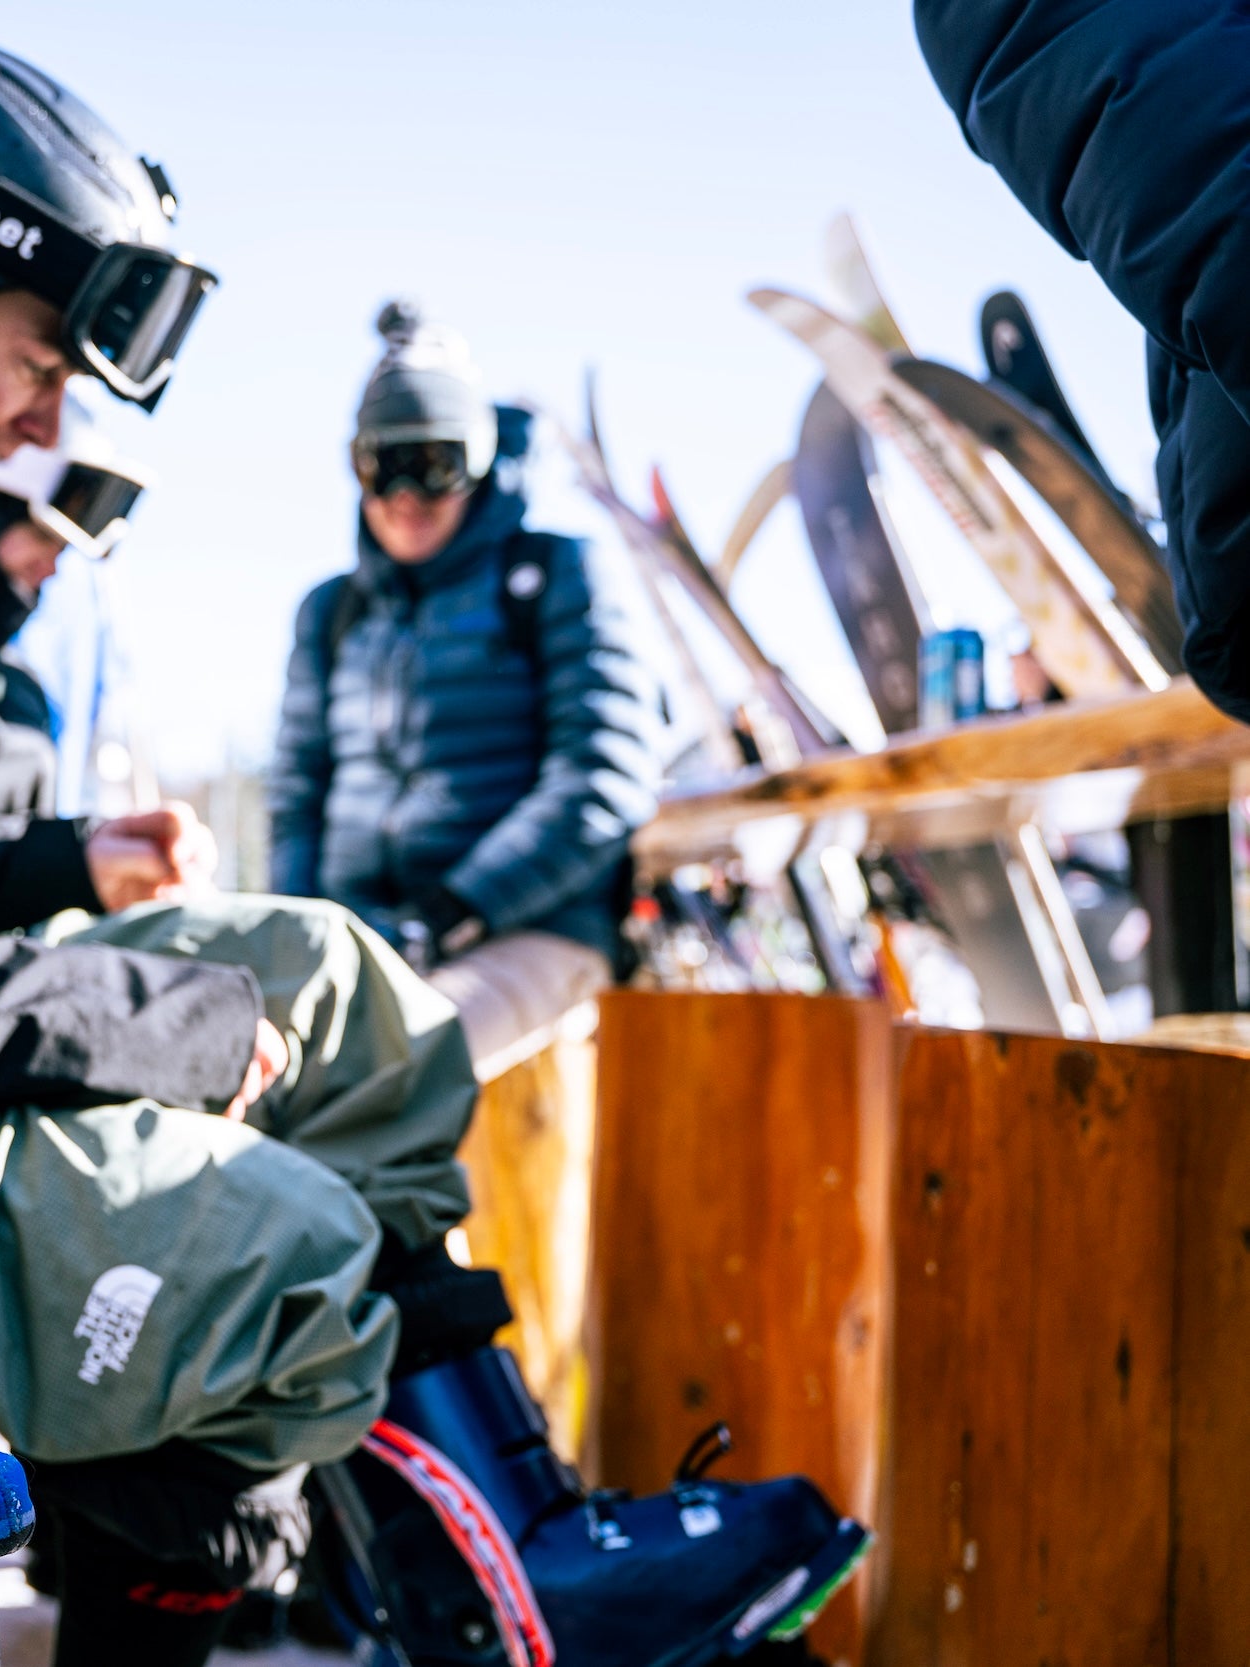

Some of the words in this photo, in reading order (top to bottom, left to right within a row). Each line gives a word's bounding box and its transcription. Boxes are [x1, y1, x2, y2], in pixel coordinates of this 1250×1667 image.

[73, 1293, 110, 1337] THE
[77, 1300, 129, 1383] NORTH
[103, 1312, 144, 1372] FACE
